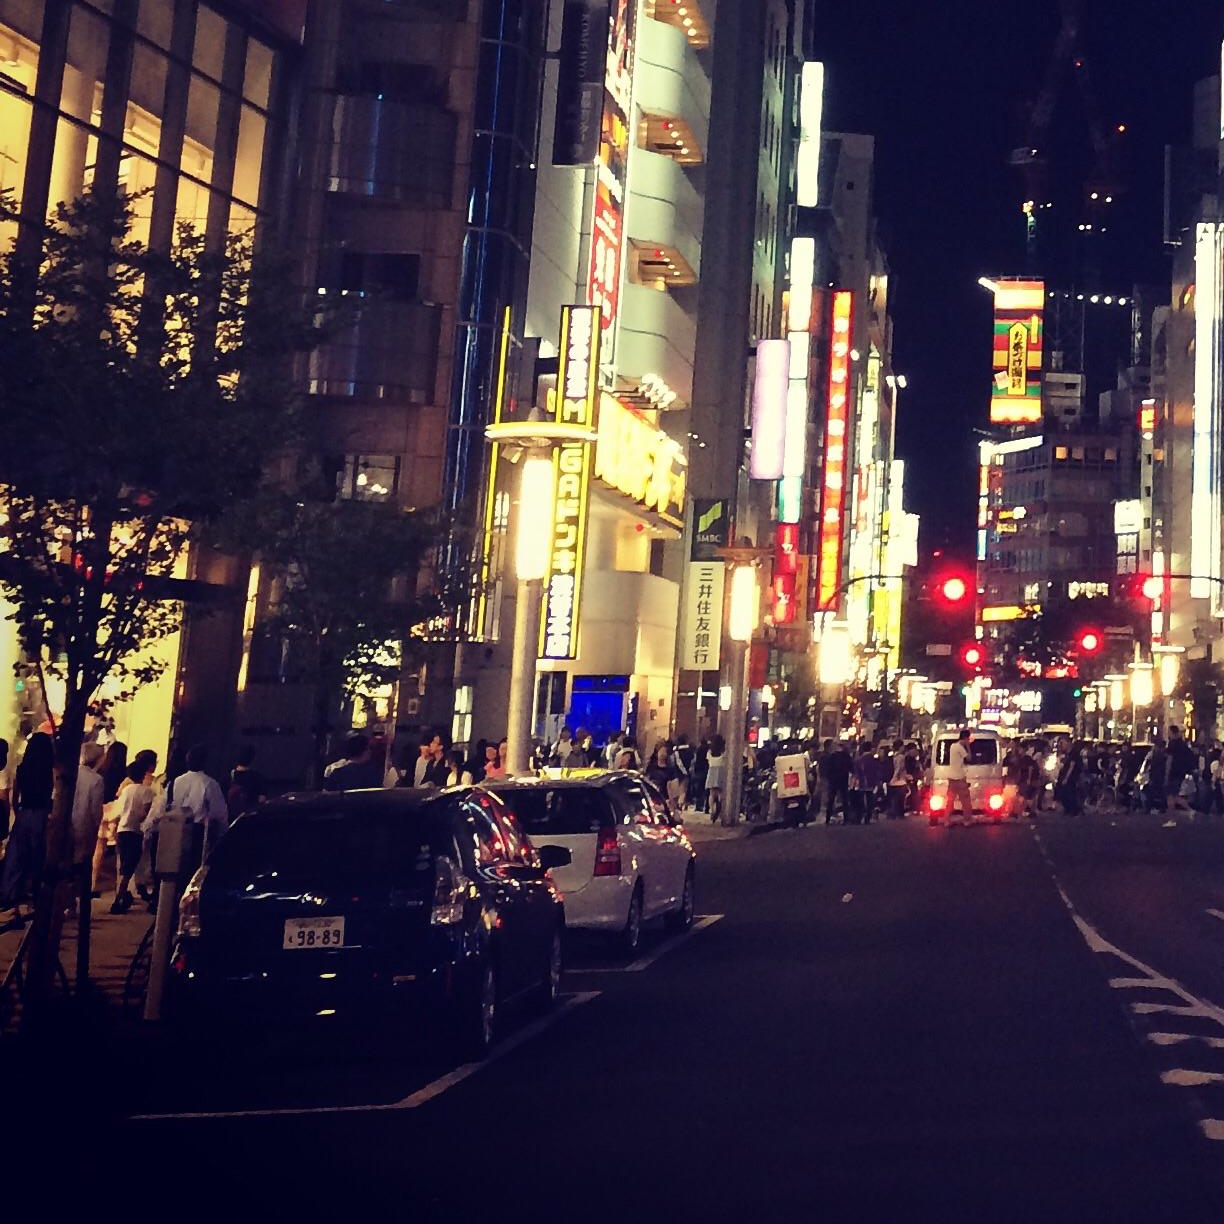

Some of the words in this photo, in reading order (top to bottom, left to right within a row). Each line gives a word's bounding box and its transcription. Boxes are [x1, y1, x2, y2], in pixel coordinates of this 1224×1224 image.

[693, 567, 714, 664] 三井住友銀行
[297, 929, 342, 947] 98-89
